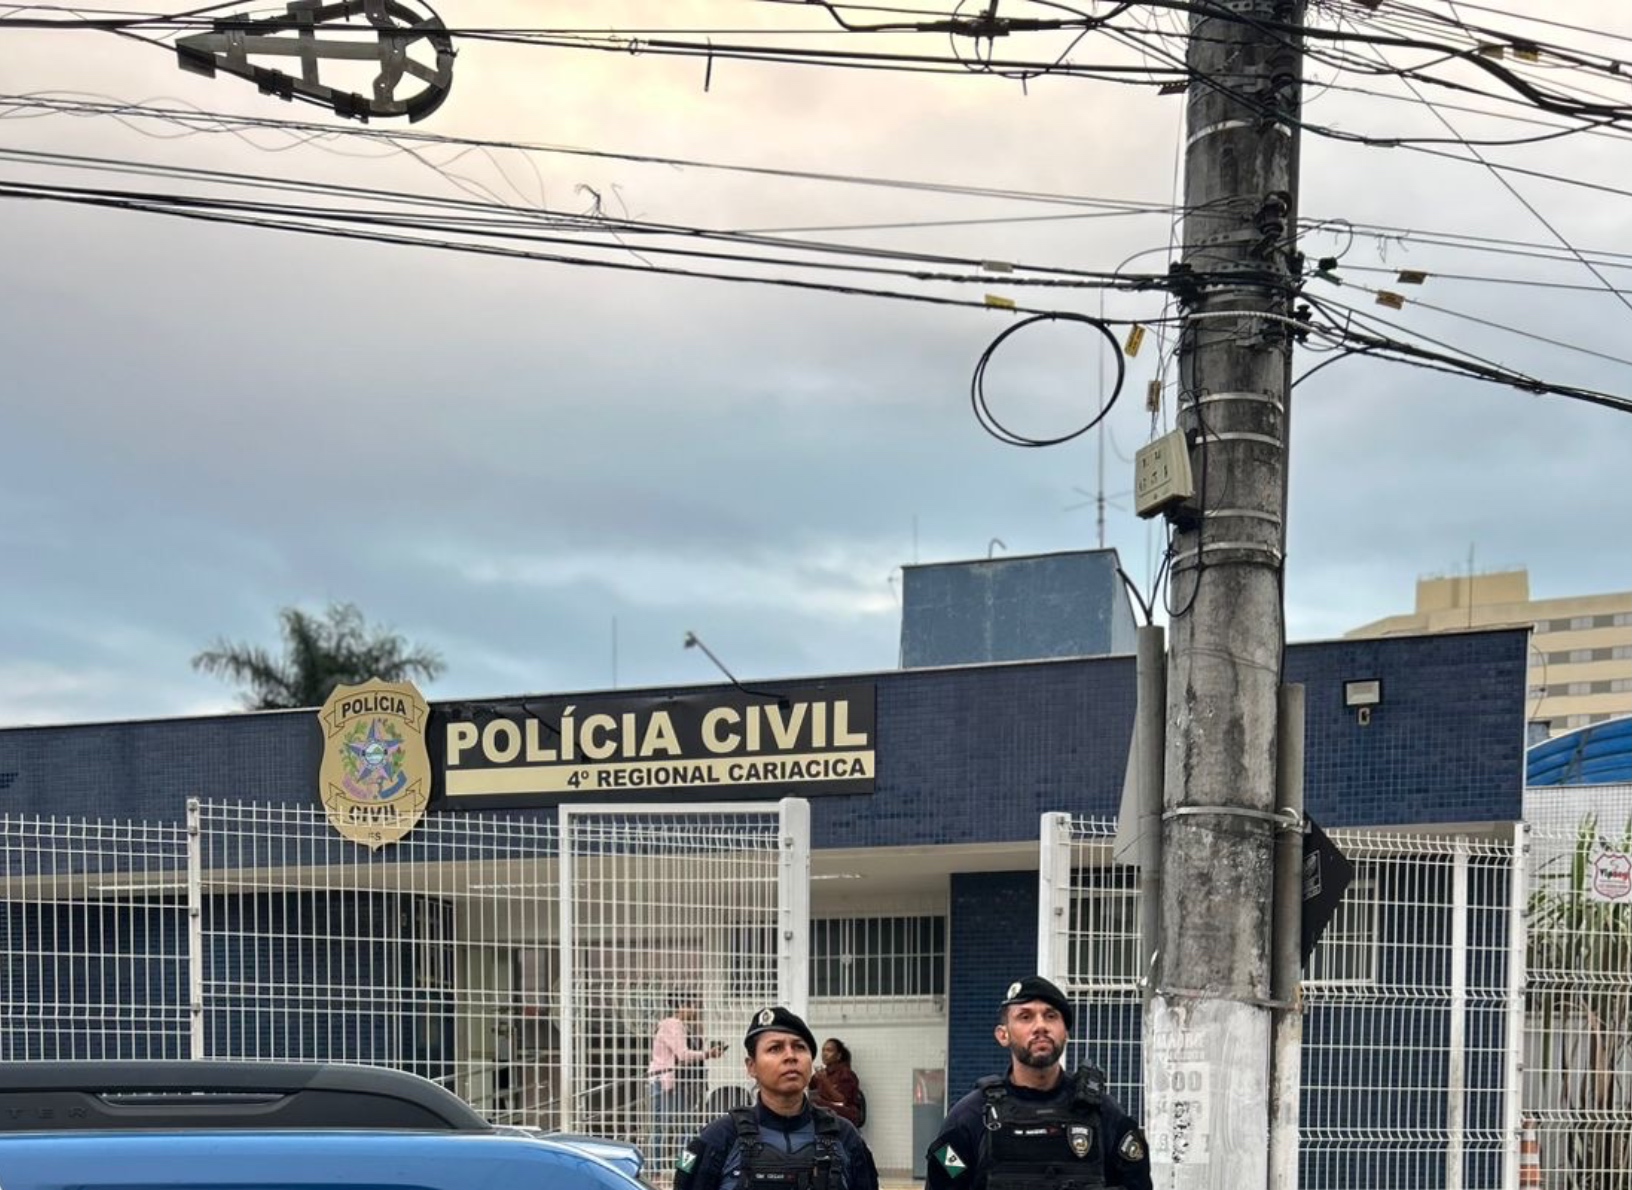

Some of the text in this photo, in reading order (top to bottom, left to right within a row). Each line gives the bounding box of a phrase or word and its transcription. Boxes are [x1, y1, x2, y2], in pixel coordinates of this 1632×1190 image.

[341, 691, 407, 718] POLÍCIA
[446, 700, 868, 766] POLÍCIA CIVIL
[597, 764, 720, 788] REGIONAL
[728, 757, 867, 782] CARIACICA
